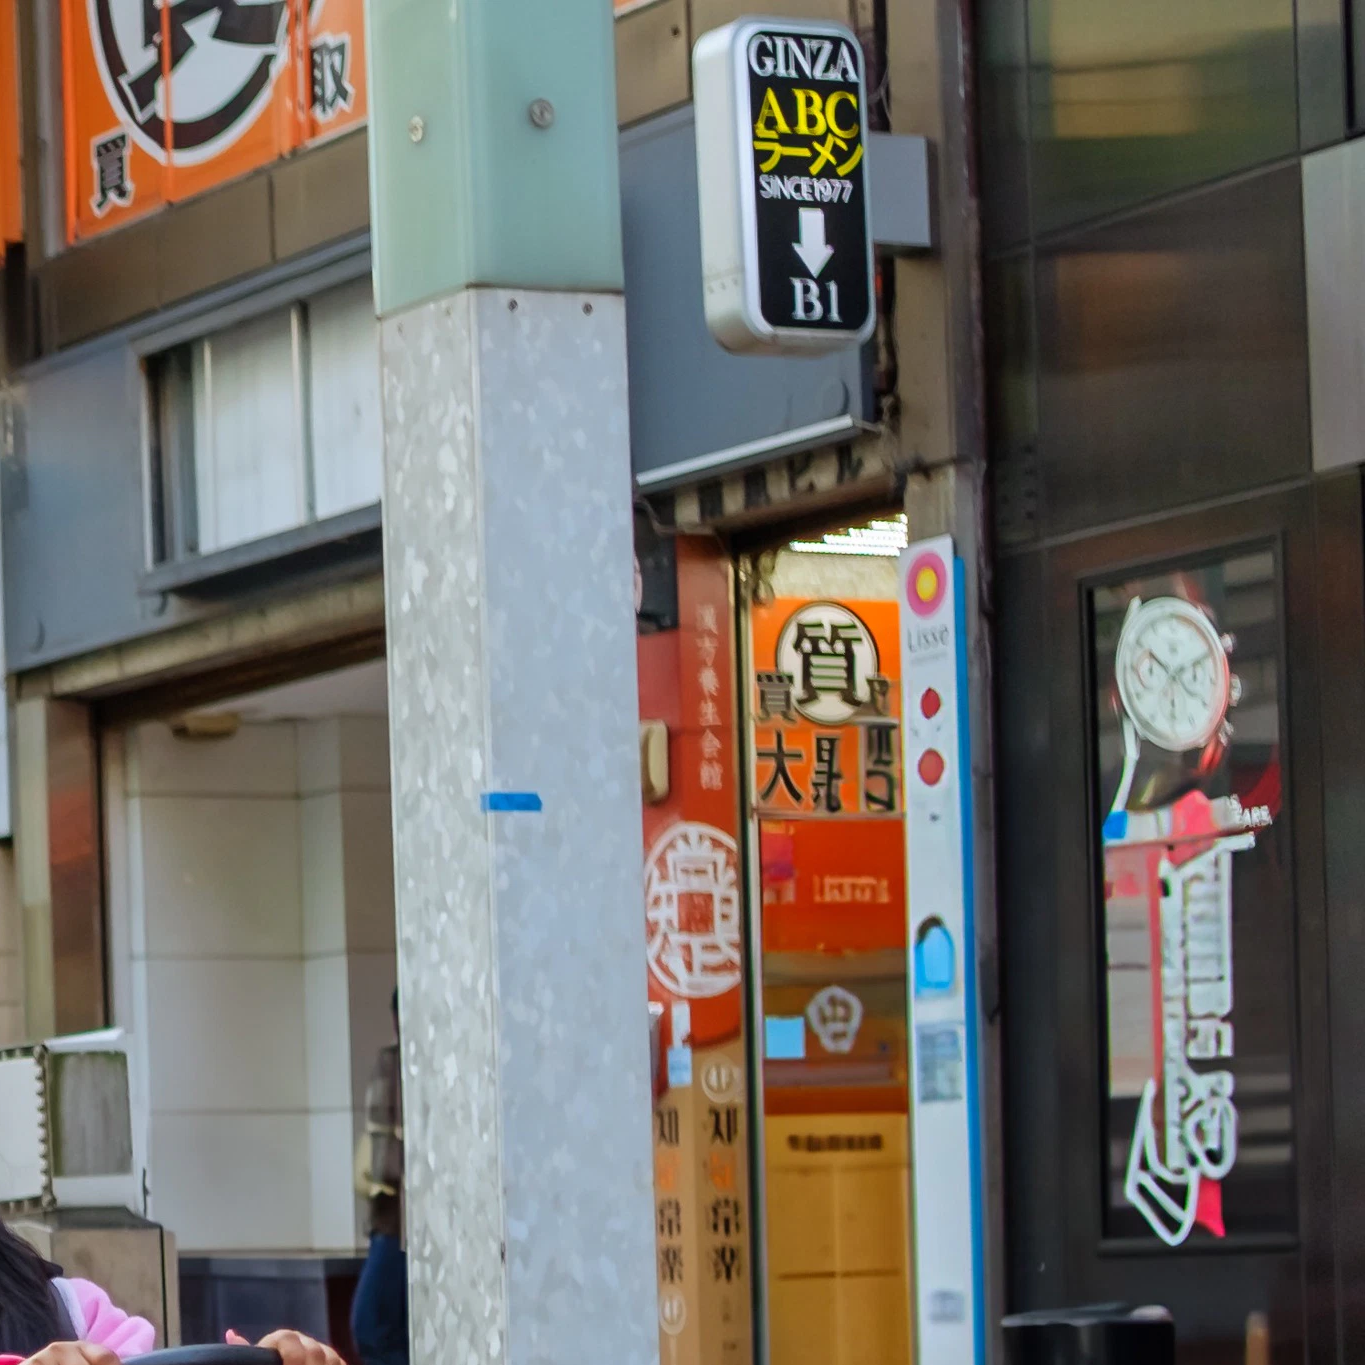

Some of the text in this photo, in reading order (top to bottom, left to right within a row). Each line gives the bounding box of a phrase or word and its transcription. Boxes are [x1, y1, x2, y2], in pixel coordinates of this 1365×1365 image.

[748, 33, 860, 82] GINZA
[755, 87, 860, 138] ABC
[753, 131, 863, 176] ラーメン
[789, 276, 843, 323] B1
[792, 621, 865, 708] 質
